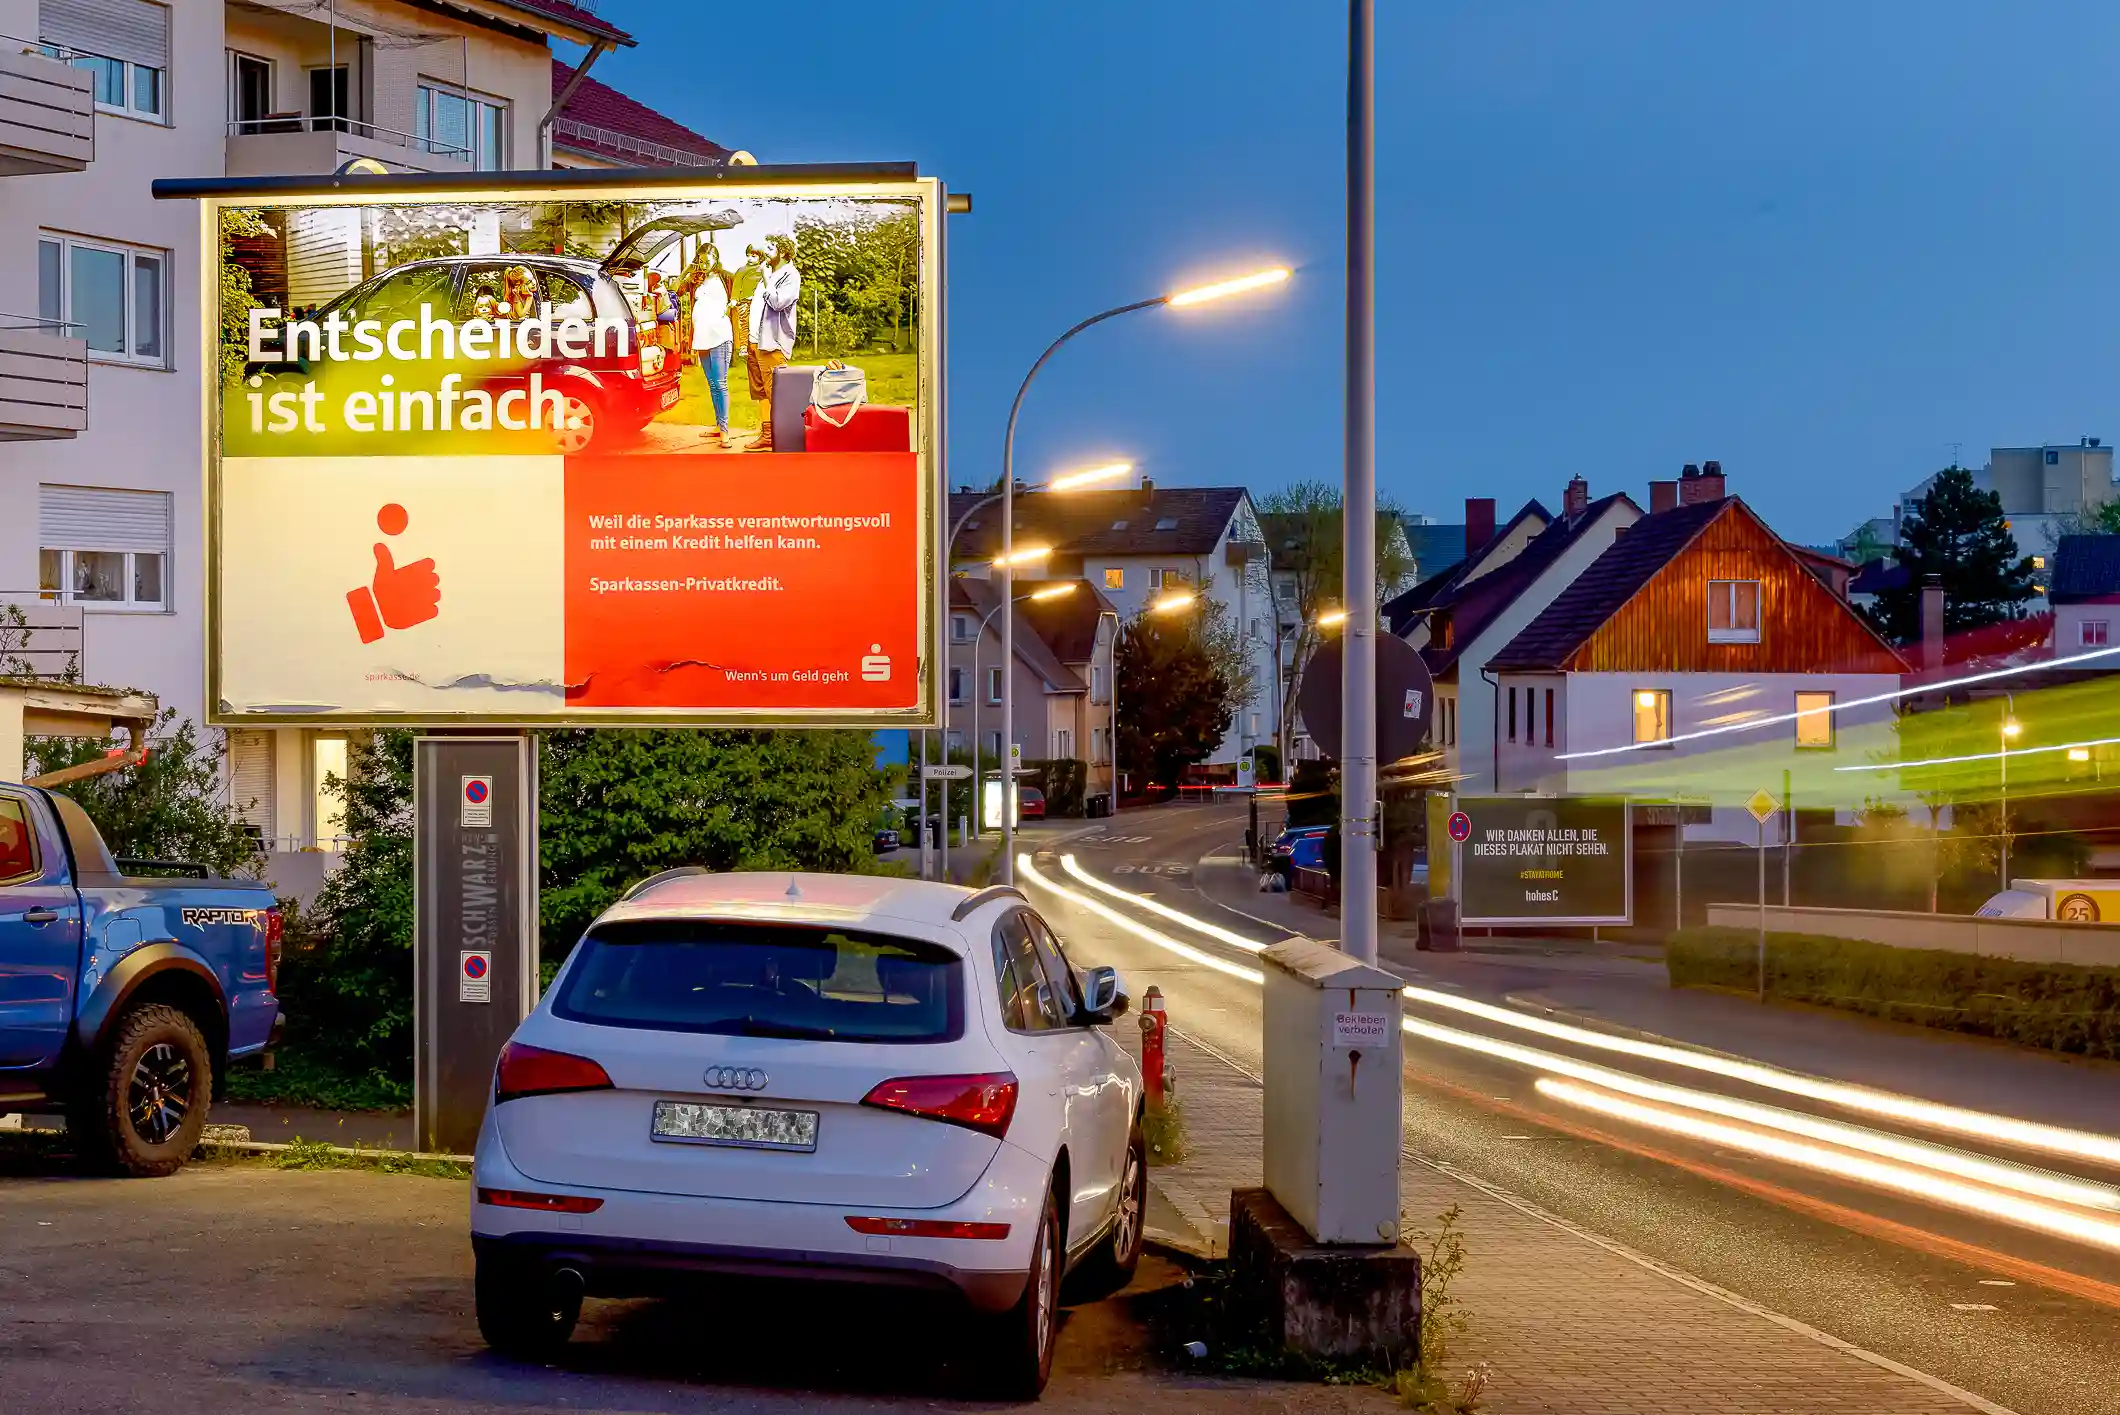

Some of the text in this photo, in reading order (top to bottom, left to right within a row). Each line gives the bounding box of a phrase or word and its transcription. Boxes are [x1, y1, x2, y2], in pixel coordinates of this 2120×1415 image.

[248, 302, 629, 362] Entscheiden
[246, 373, 582, 435] ist einfach.
[588, 513, 891, 532] Weil die Sparkasse verantwortungsvoll
[590, 534, 821, 550] mit einem Kredit helfen kann.
[589, 576, 785, 595] Sparkassen-Privatkredit.
[770, 672, 789, 683] um
[791, 670, 818, 683] Geld
[821, 671, 849, 685] geht
[933, 768, 957, 776] Polizei
[1486, 829, 1598, 843] WIR DANKEN ALLEN, DIE
[1474, 843, 1609, 856] DIESES PLAKAT NICHT SEHEN.
[462, 845, 497, 946] SCHWARZ
[181, 907, 263, 933] RAPTOR
[2067, 907, 2090, 920] 25
[1336, 1014, 1386, 1024] Bekleben
[1339, 1025, 1385, 1035] verboten
